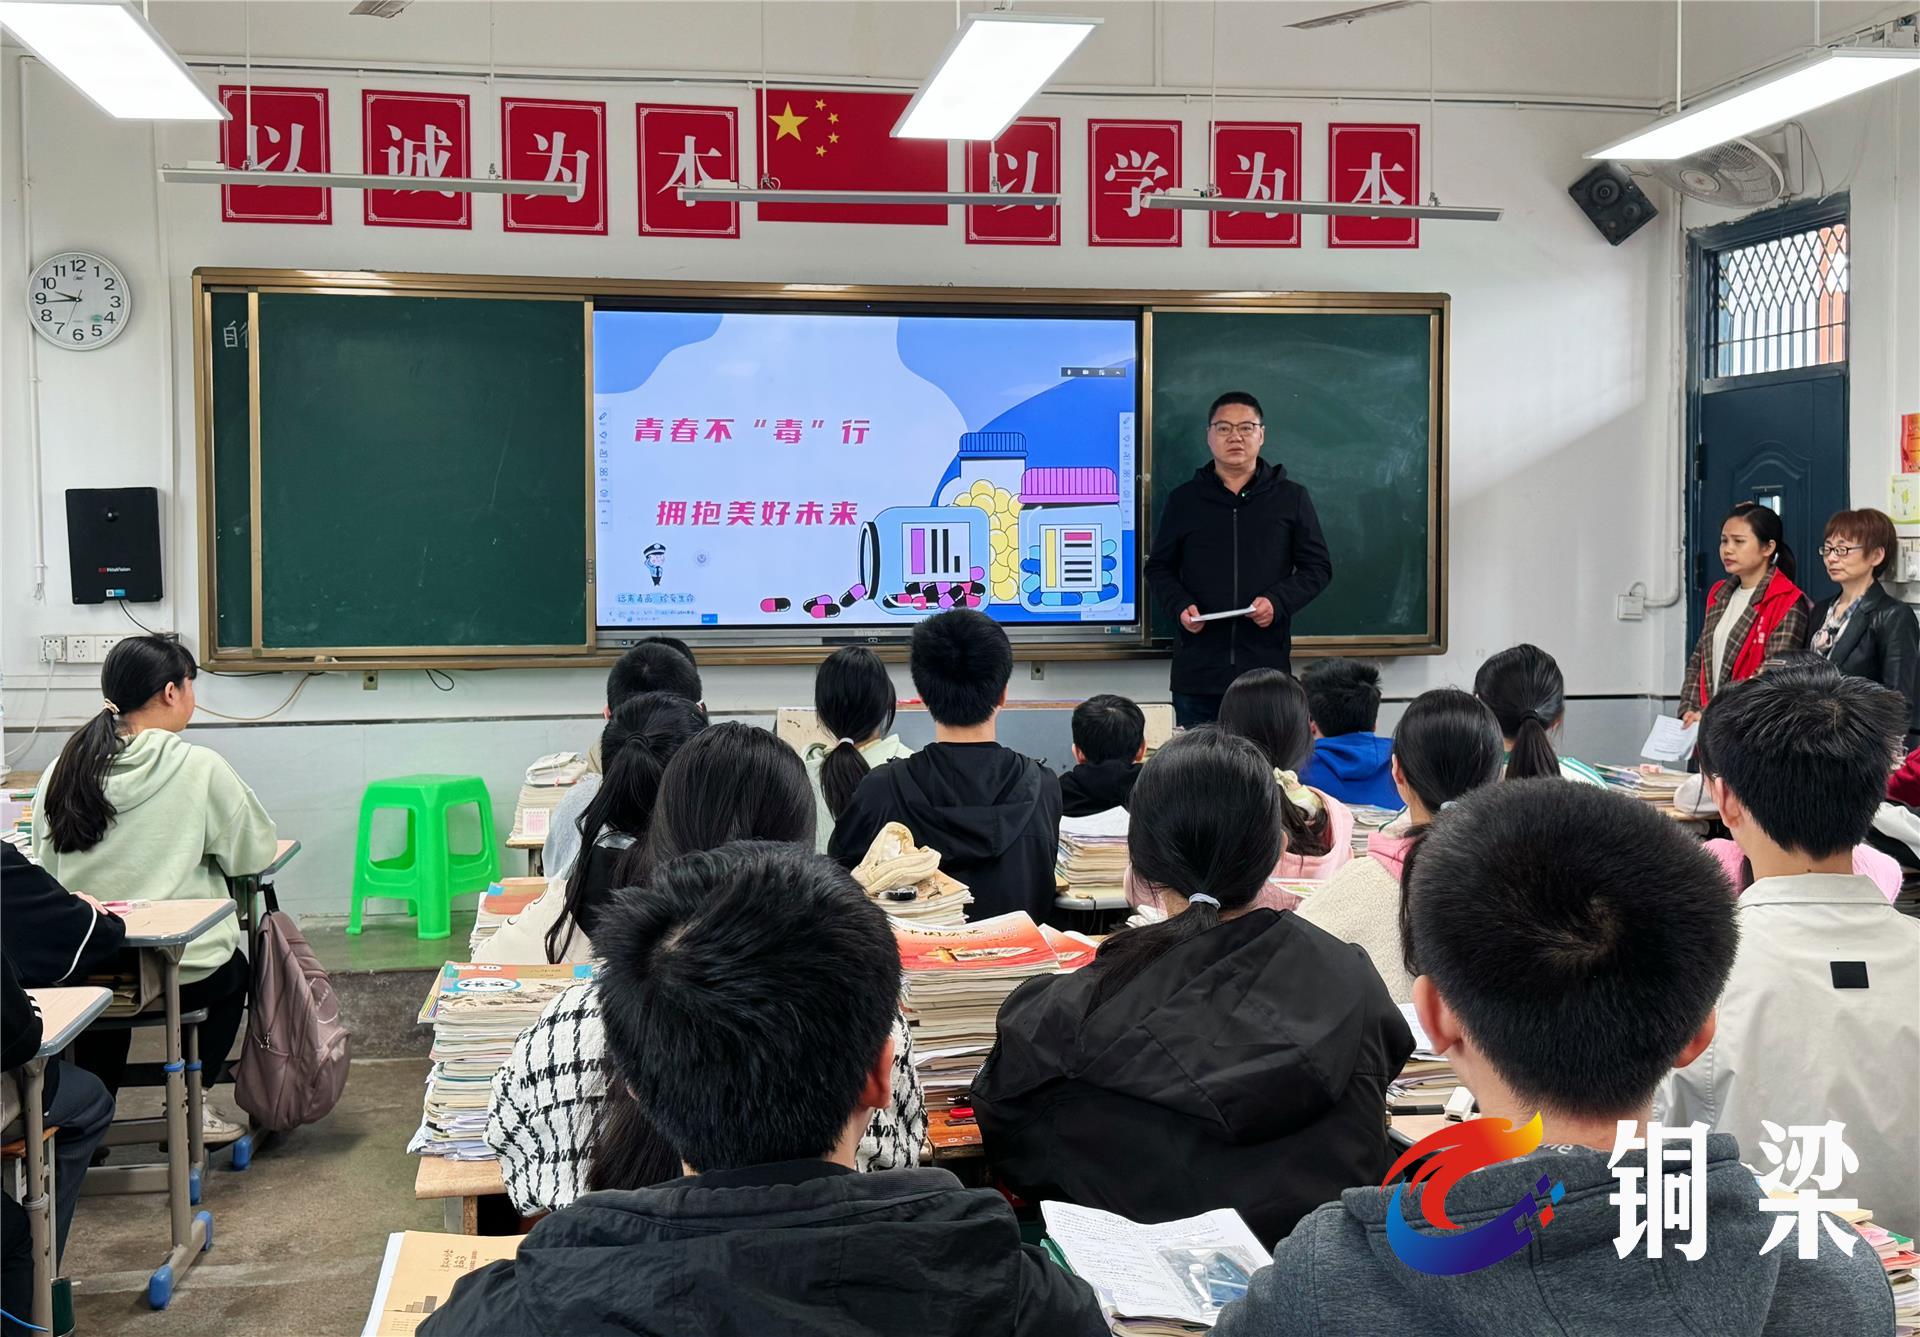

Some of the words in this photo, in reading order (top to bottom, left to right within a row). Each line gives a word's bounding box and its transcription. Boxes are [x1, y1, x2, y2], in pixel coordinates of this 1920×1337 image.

[53, 265, 66, 277] 11
[70, 259, 87, 272] 12
[93, 265, 100, 278] 1
[40, 277, 57, 290] 10
[104, 278, 115, 290] 2
[35, 292, 47, 305] 9
[110, 295, 121, 308] 3
[41, 309, 53, 322] 8
[103, 311, 116, 324] 4
[54, 321, 65, 334] 7
[91, 324, 103, 336] 5
[72, 328, 84, 341] 6
[656, 500, 858, 526] 拥抱美好未来
